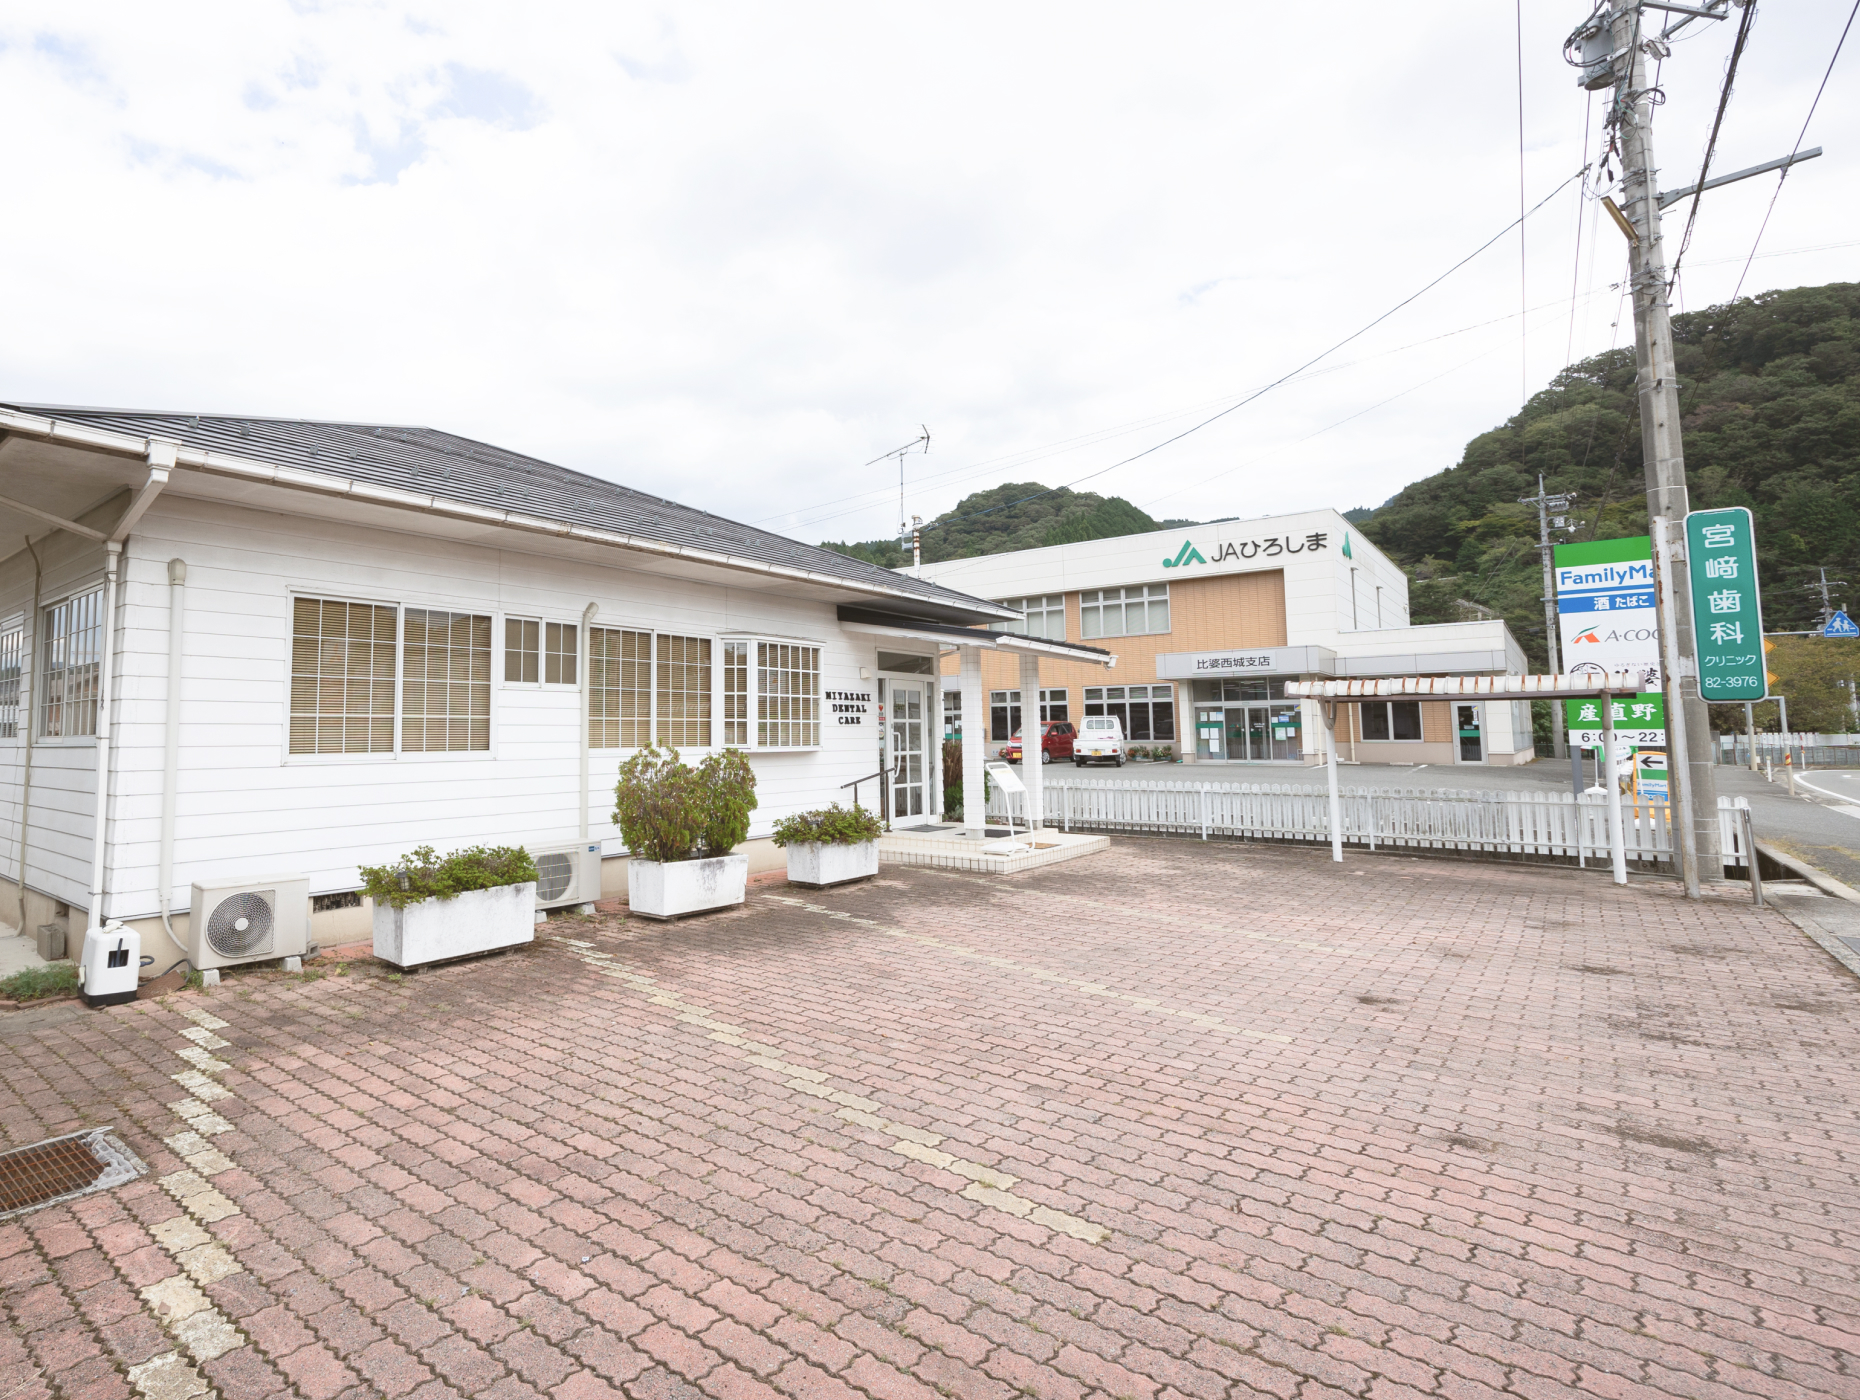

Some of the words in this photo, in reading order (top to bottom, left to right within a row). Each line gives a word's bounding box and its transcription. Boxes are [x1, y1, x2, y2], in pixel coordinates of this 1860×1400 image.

[1211, 532, 1328, 562] JAひろしま
[1593, 596, 1610, 610] 酒
[1615, 595, 1650, 608] たばこ
[1196, 655, 1271, 670] 比婆西城支店
[1704, 654, 1757, 667] クリニック
[1704, 675, 1758, 688] 82-3976
[825, 691, 871, 702] MIYAZAKI
[832, 703, 867, 713] DENTAL
[1577, 702, 1664, 721] 産直野
[838, 716, 861, 725] CARE
